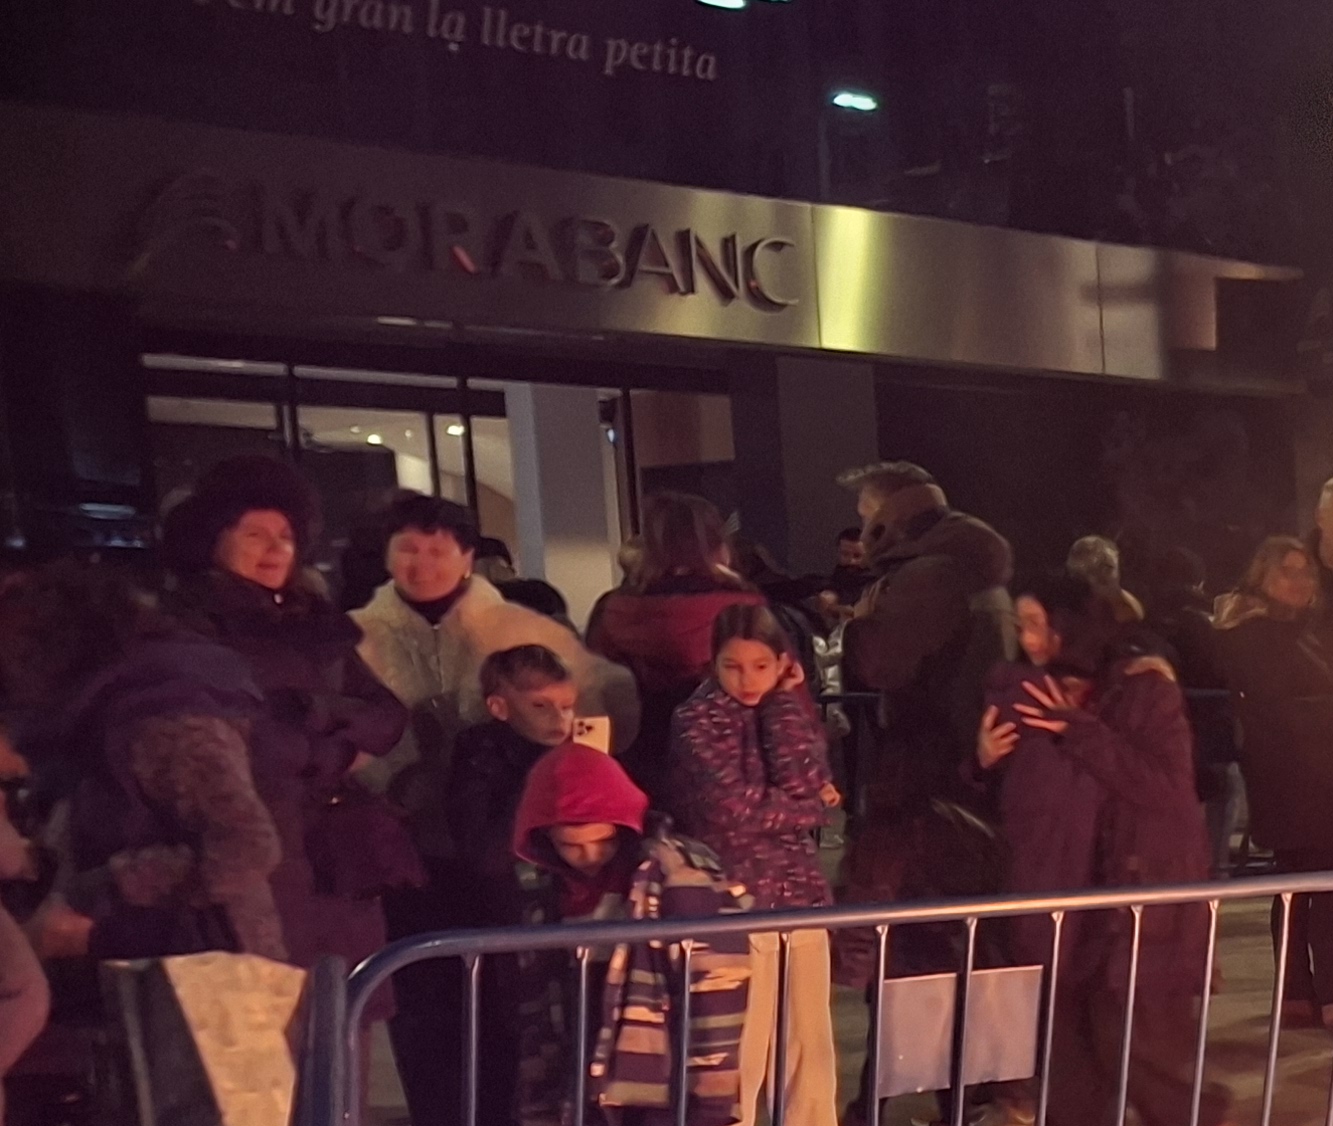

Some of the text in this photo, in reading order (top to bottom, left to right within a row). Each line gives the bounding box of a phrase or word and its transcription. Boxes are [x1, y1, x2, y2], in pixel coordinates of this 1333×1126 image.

[426, 0, 466, 43] la
[480, 6, 591, 62] lletra
[602, 36, 718, 81] petita
[253, 194, 801, 313] MORABANC
